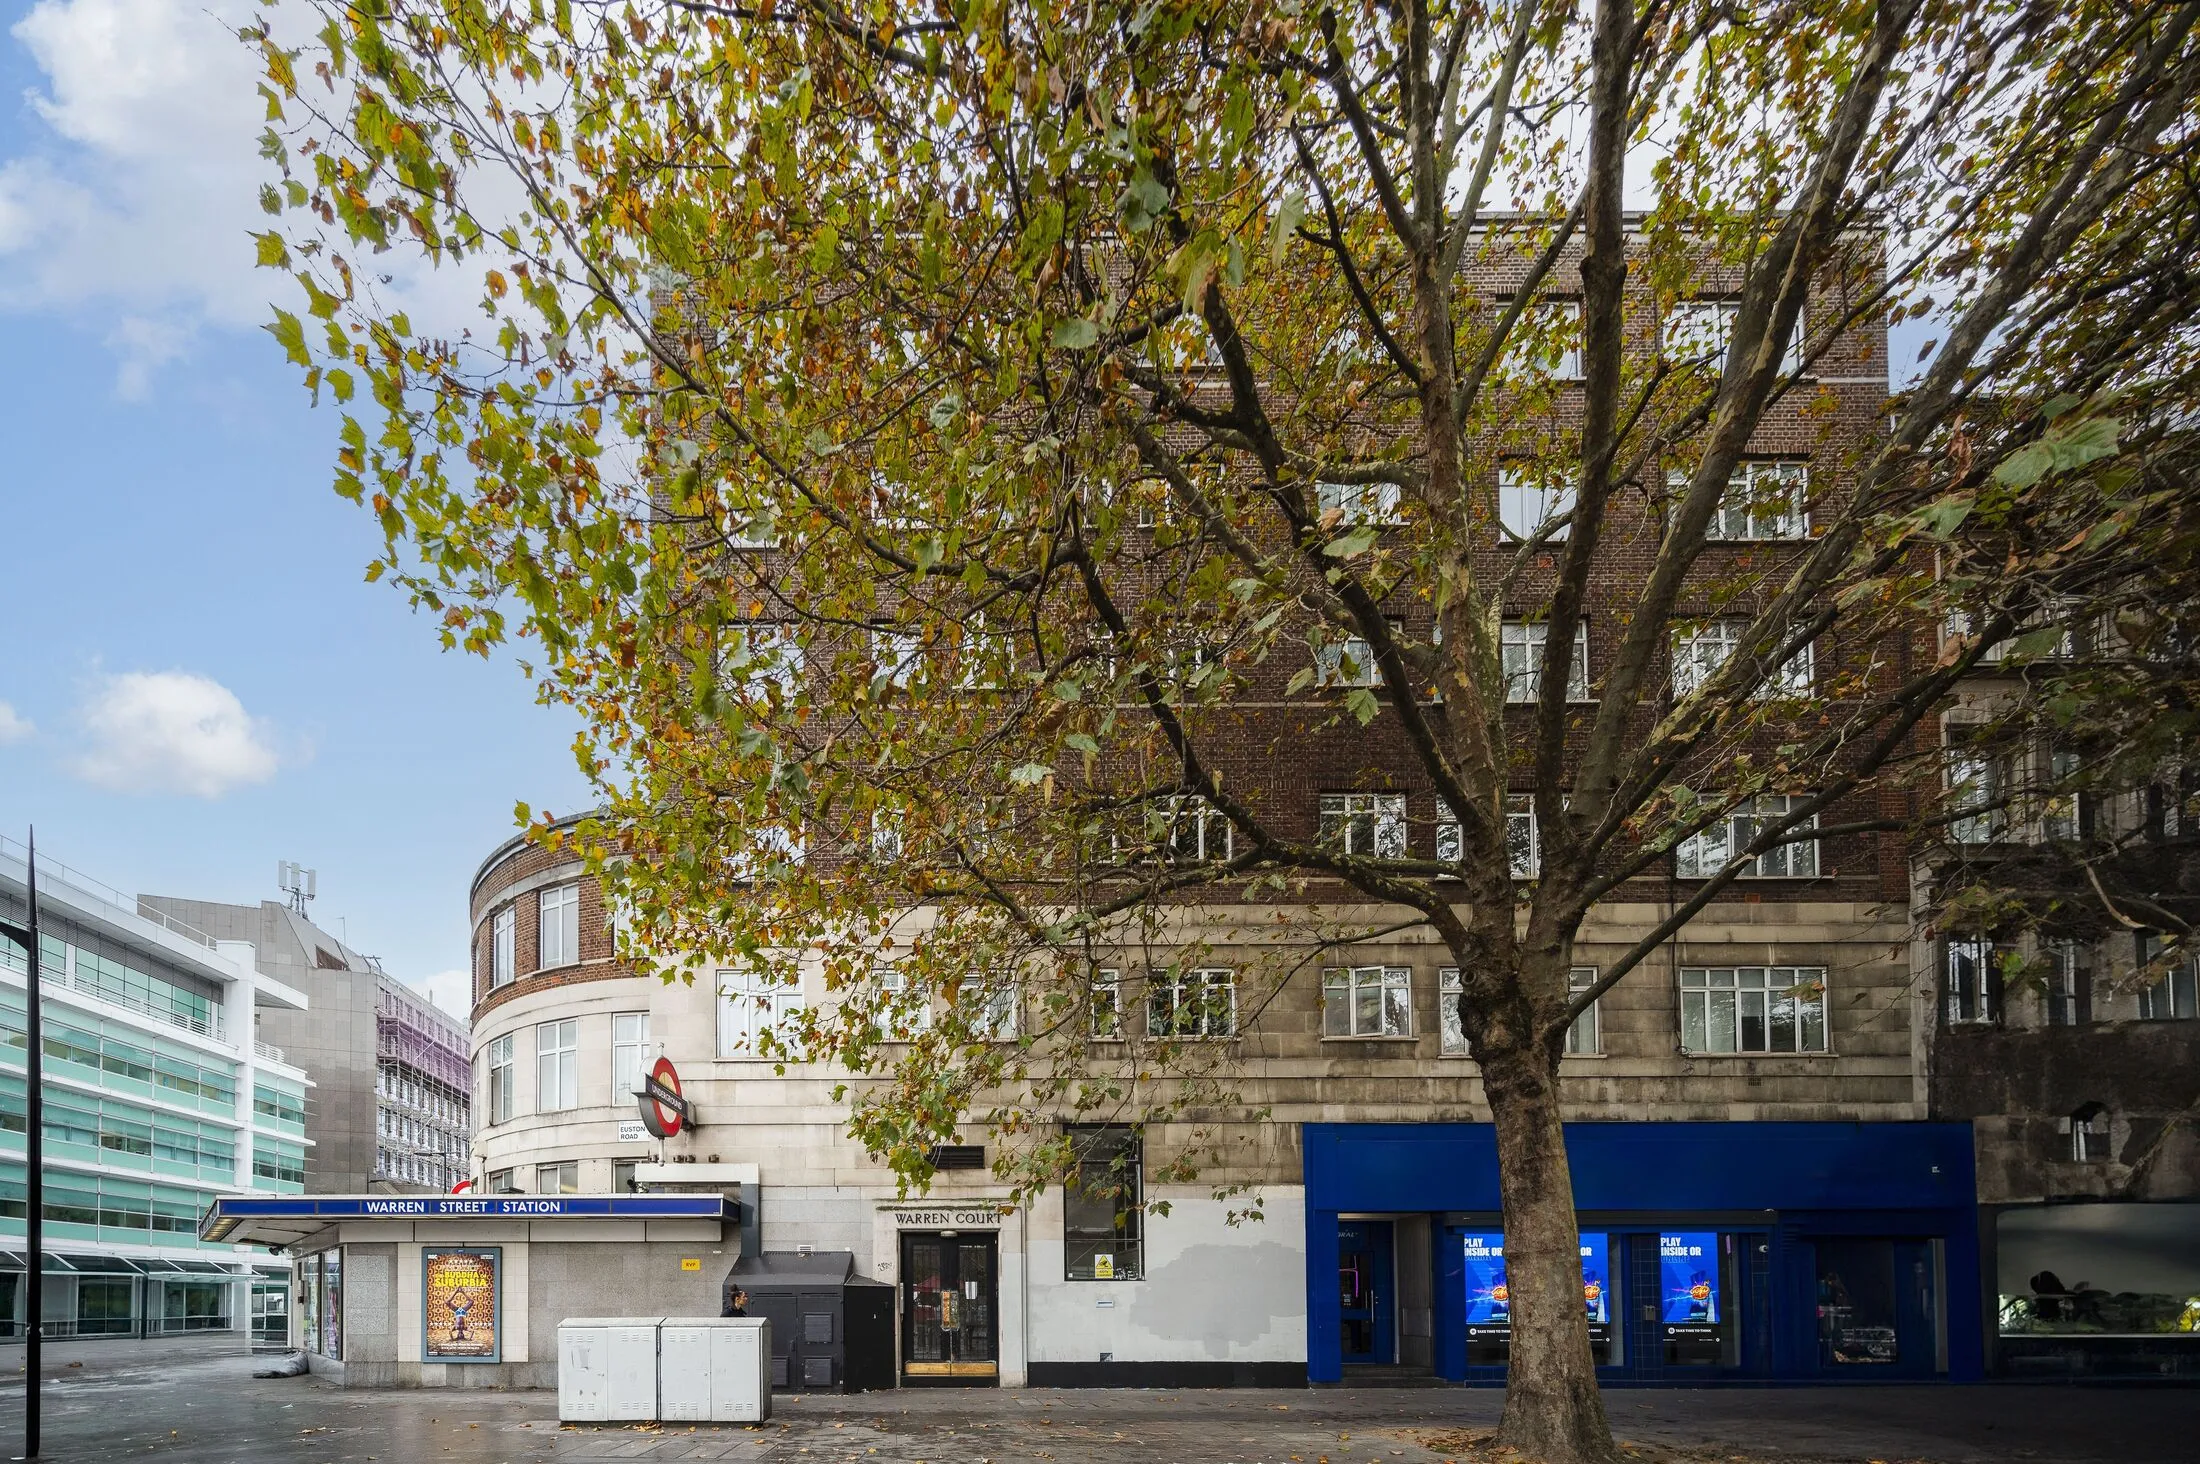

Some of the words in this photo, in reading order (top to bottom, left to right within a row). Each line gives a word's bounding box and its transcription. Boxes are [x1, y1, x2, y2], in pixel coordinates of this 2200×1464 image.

[651, 1084, 682, 1110] UNDERGROUND
[366, 1202, 425, 1213] WARREN
[439, 1202, 488, 1213] STREET
[502, 1202, 561, 1213] STATION
[895, 1213, 950, 1224] WARREN
[955, 1213, 1001, 1224] COURT
[1464, 1238, 1483, 1247] PLAY
[1660, 1237, 1681, 1246] PLAY
[1464, 1247, 1490, 1257] INSIDE
[1491, 1247, 1503, 1257] OR
[1580, 1247, 1592, 1257] OR
[1660, 1246, 1688, 1256] INSIDE
[1689, 1246, 1702, 1256] OR
[434, 1278, 487, 1287] SUBURBIA
